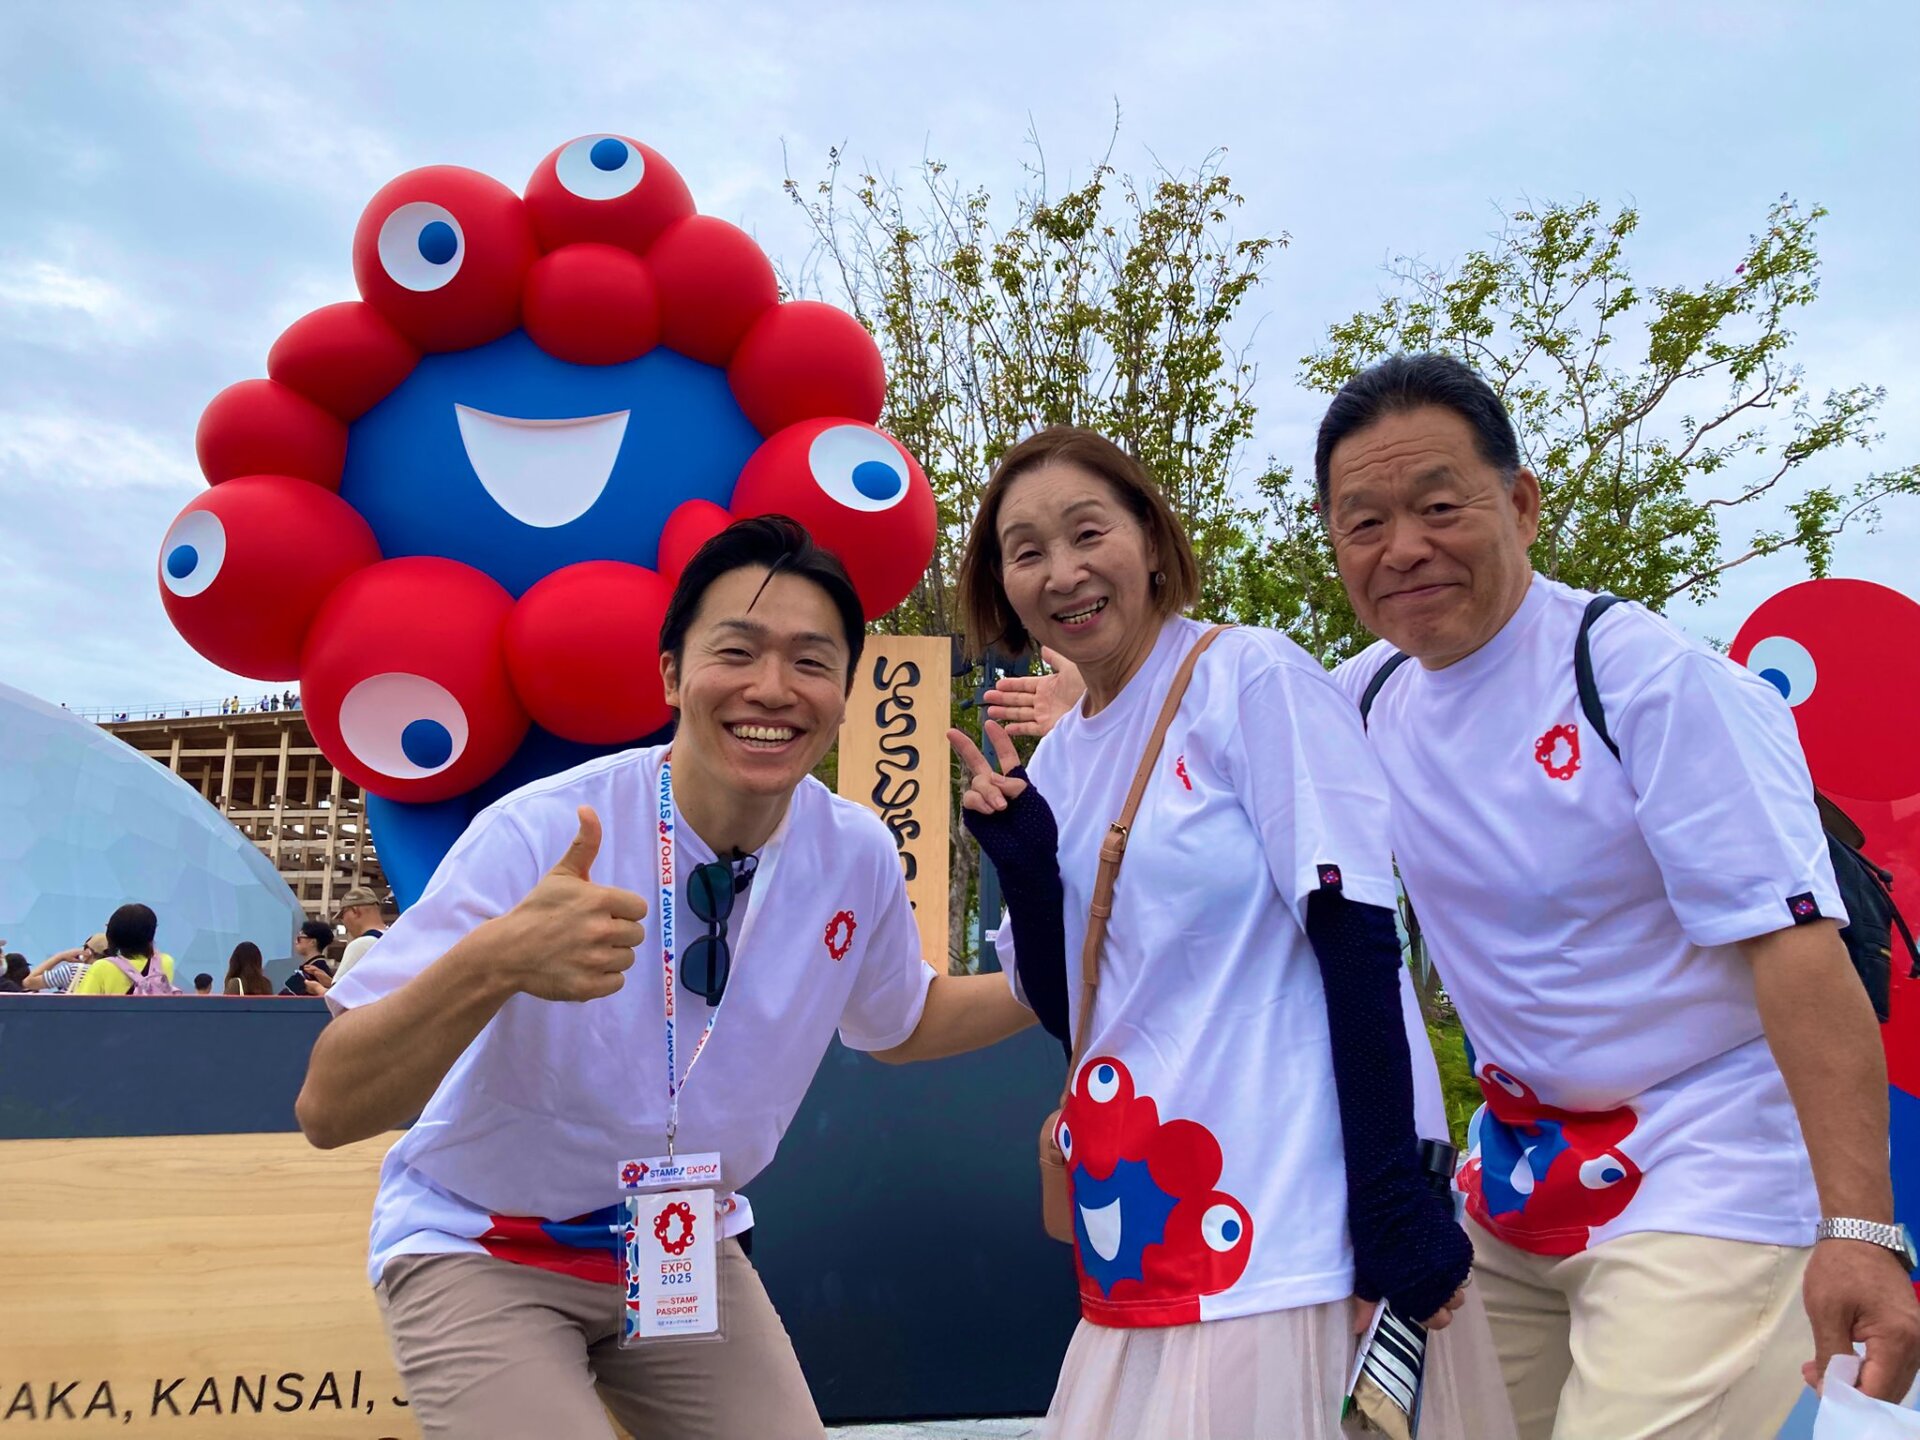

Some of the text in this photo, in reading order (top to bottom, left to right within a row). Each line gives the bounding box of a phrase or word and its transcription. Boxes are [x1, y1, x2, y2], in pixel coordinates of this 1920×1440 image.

[660, 763, 672, 819] STAMP!
[661, 836, 672, 885] EXPO!
[662, 888, 673, 948] STAMP!
[665, 966, 673, 1017] EXPO!
[650, 1164, 717, 1178] STAMP! EXPO!
[660, 1261, 692, 1274] EXPO
[661, 1272, 692, 1285] 2025
[656, 1305, 698, 1316] PASSPORT
[670, 1295, 698, 1305] STAMP
[0, 1369, 375, 1425] AKA, KANSAI,
